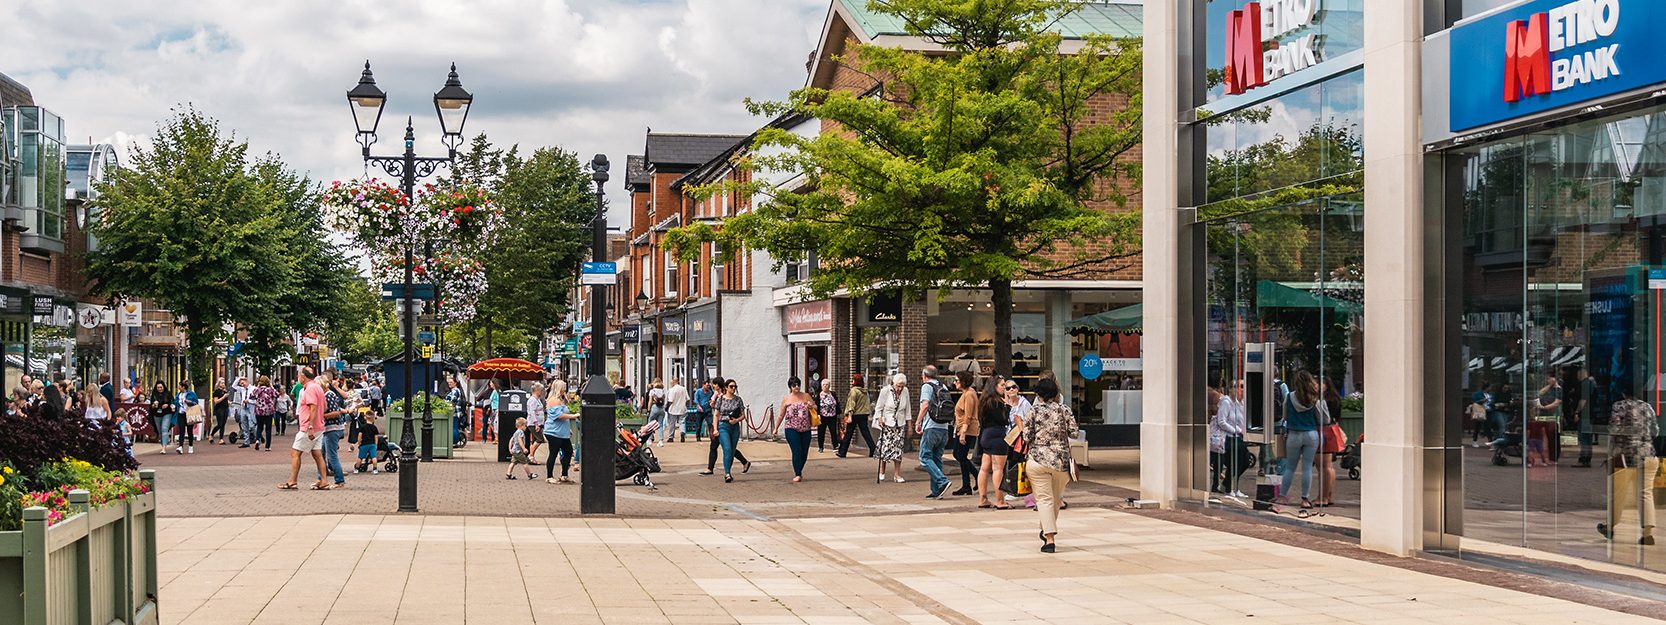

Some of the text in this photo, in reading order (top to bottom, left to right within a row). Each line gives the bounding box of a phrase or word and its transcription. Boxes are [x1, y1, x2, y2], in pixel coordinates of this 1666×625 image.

[1263, 33, 1317, 83] BANK
[1503, 0, 1620, 102] METRO
[1552, 44, 1619, 91] BANK
[1083, 359, 1098, 368] 20%
